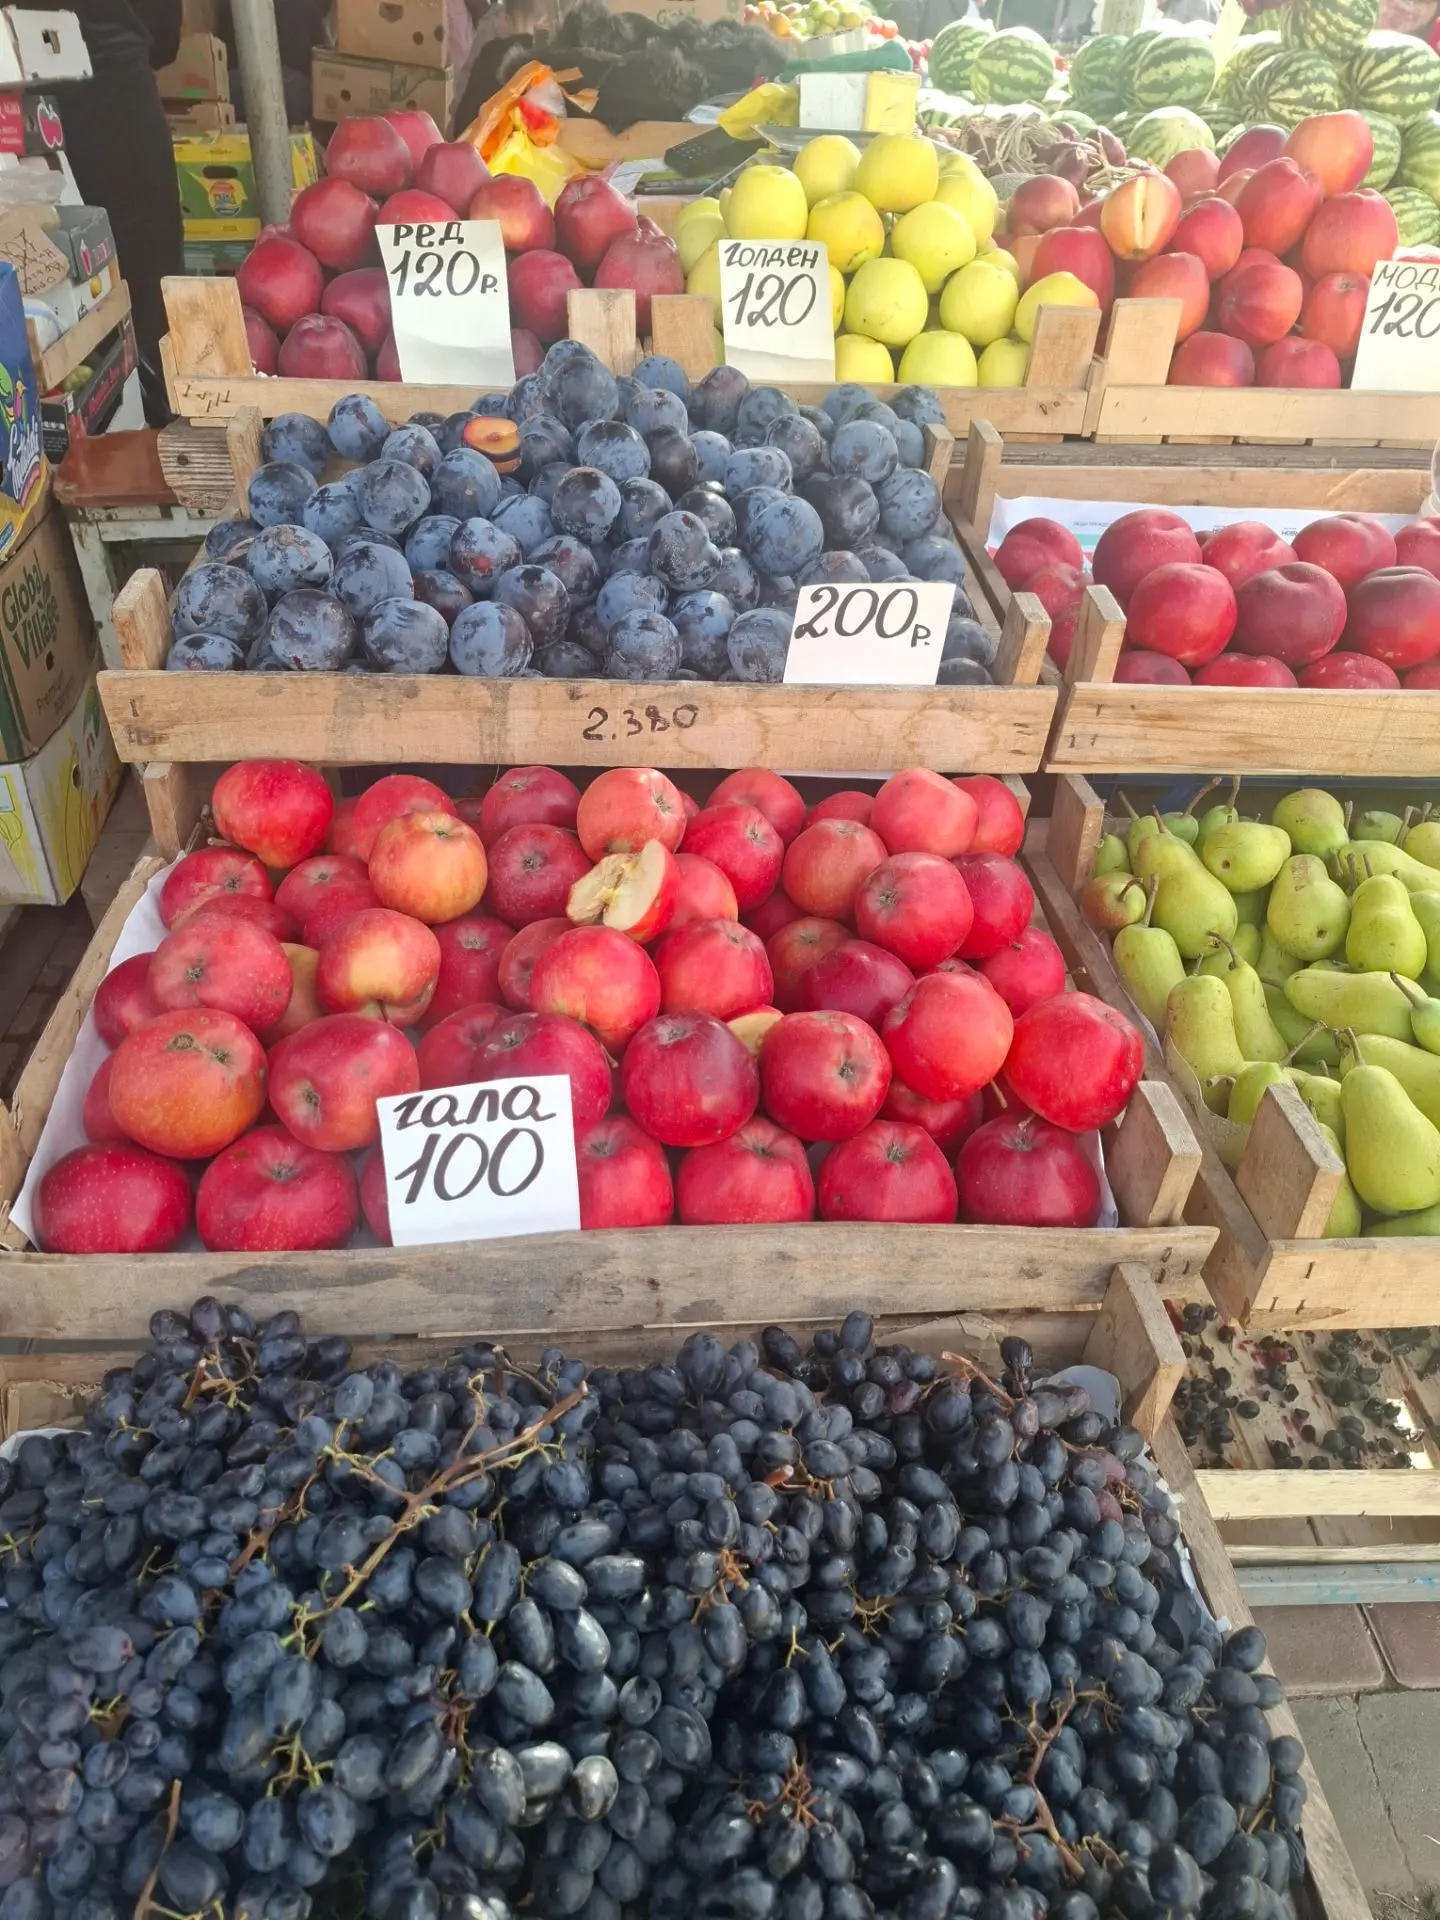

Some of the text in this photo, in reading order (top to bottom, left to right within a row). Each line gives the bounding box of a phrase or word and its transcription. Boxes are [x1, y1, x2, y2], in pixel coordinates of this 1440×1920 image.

[728, 273, 817, 327] 120
[1374, 264, 1440, 293] МОД
[1369, 291, 1440, 338] 120
[2, 550, 44, 632] Global
[13, 594, 60, 671] Village
[394, 1128, 545, 1204] 100
